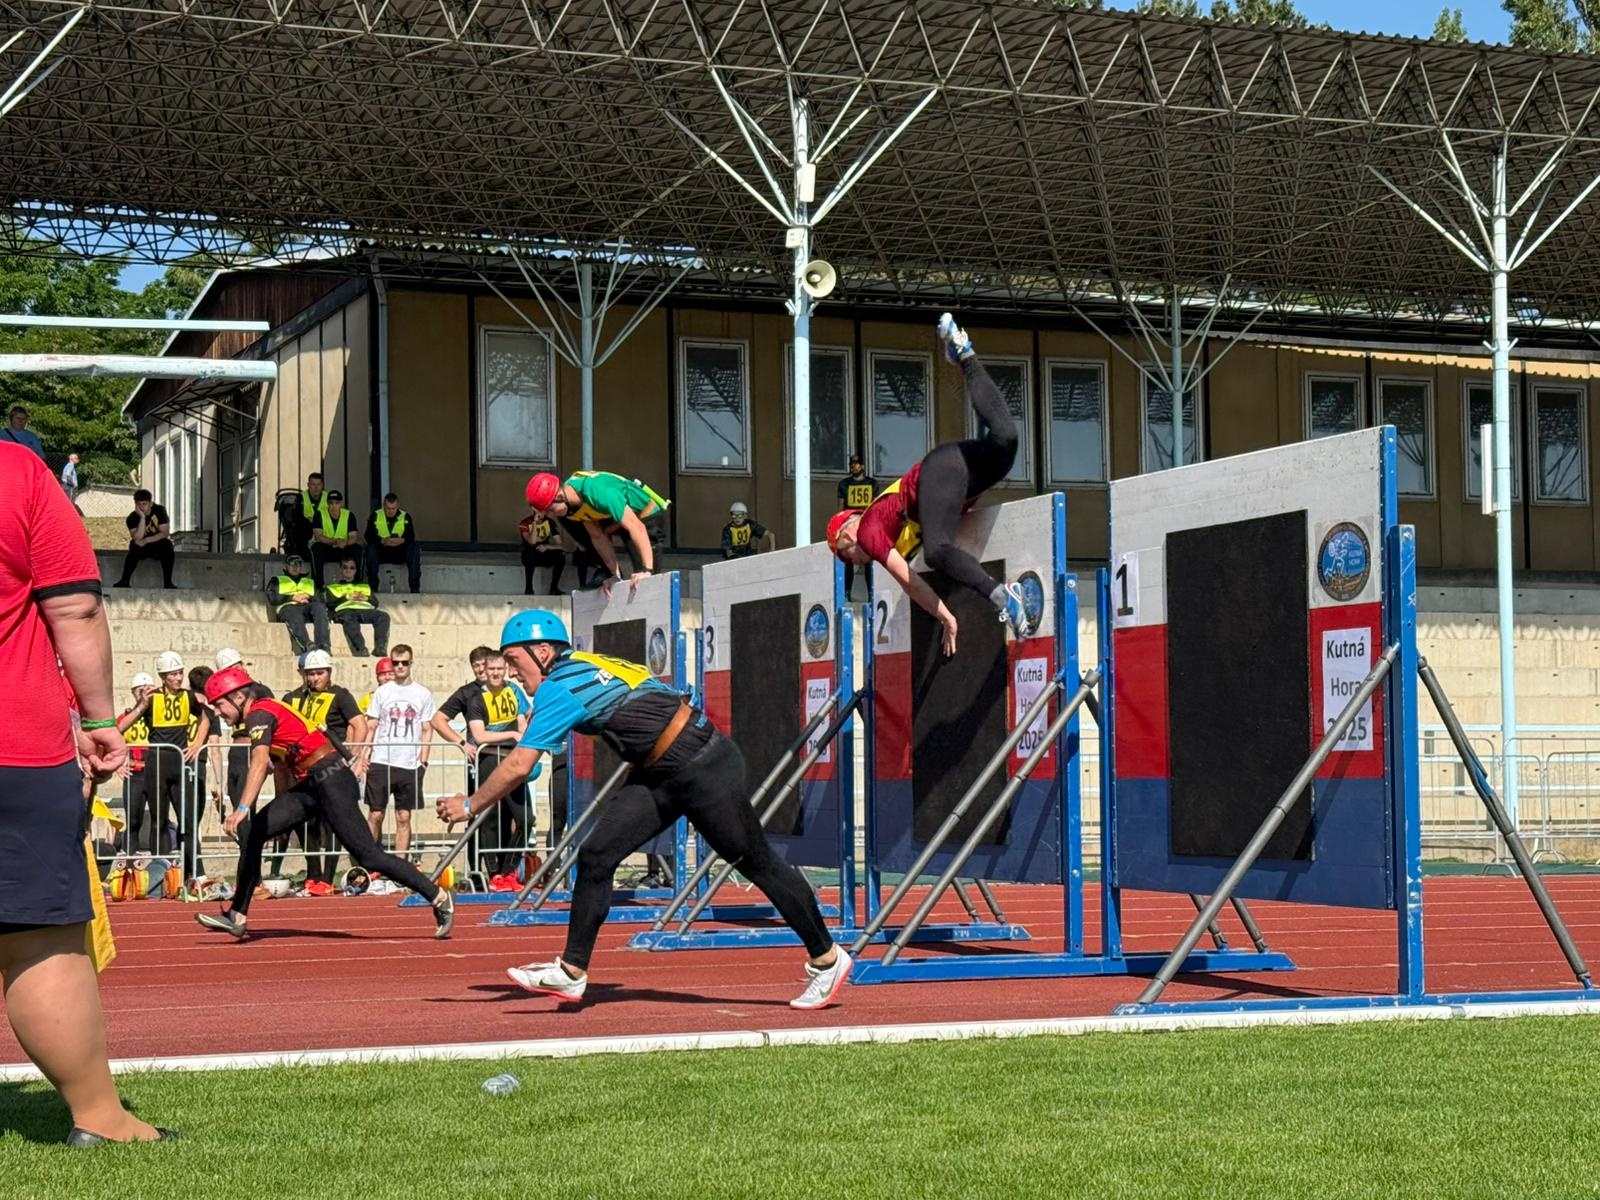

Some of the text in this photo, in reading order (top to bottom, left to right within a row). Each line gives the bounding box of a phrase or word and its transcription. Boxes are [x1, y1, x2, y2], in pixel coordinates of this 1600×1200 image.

[850, 487, 869, 504] 156
[737, 528, 748, 545] 93
[1116, 563, 1134, 616] 1
[877, 600, 889, 644] 2
[705, 625, 715, 664] 3
[1326, 636, 1365, 659] Kutná
[1017, 665, 1043, 683] Kutná
[492, 692, 516, 720] 146
